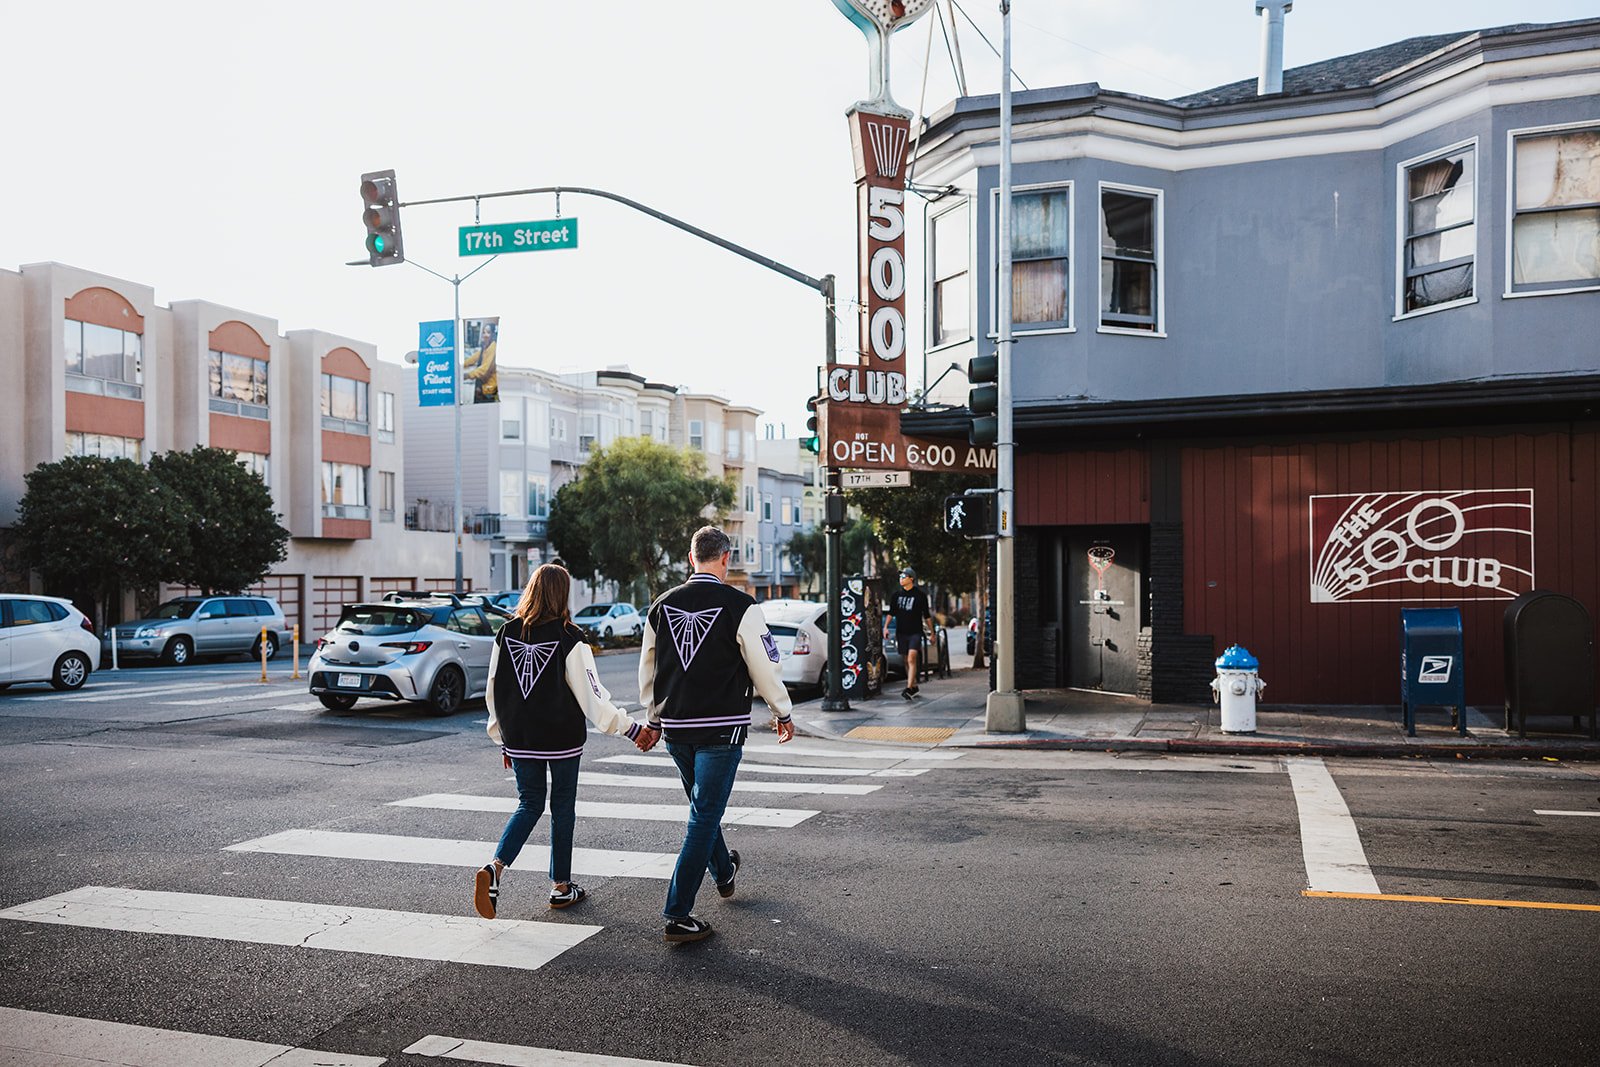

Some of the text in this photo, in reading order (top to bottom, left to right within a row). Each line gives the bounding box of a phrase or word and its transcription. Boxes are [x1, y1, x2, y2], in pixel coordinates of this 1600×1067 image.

[465, 225, 569, 252] 17th Street
[868, 186, 906, 361] 500
[426, 361, 450, 373] Great
[828, 368, 907, 405] CLUB
[832, 440, 997, 469] OPEN 6:00 AM
[885, 473, 899, 483] ST
[1329, 503, 1382, 548] THE
[1333, 498, 1466, 592] 500
[1406, 556, 1501, 588] CLUB
